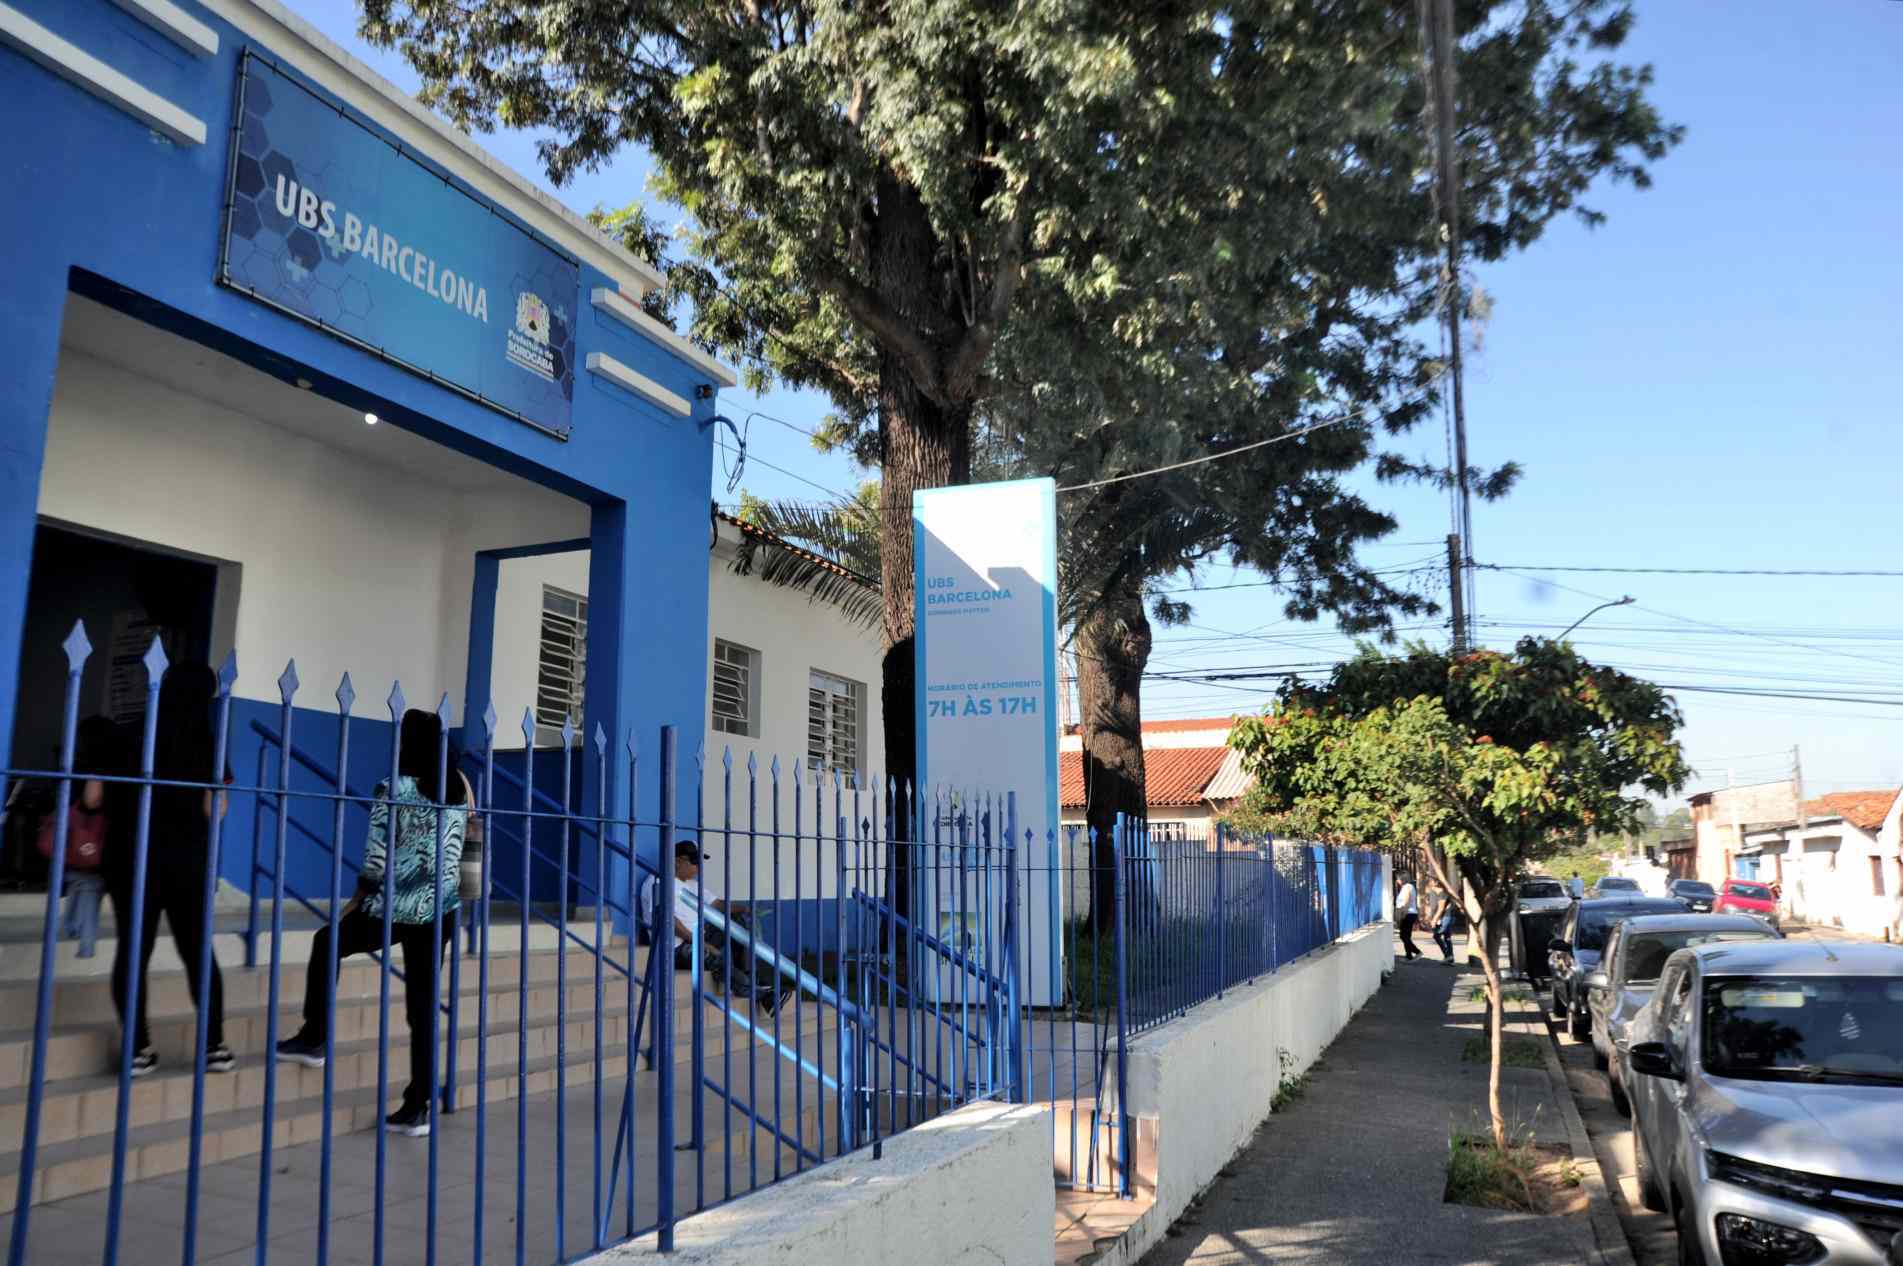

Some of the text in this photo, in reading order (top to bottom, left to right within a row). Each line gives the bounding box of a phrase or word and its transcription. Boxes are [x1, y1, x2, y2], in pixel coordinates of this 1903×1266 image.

[276, 173, 489, 323] UBS BARCELONA
[927, 576, 955, 589] UBS
[927, 589, 1012, 605] BARCELONA
[928, 694, 1037, 718] 7H ÀS 17H
